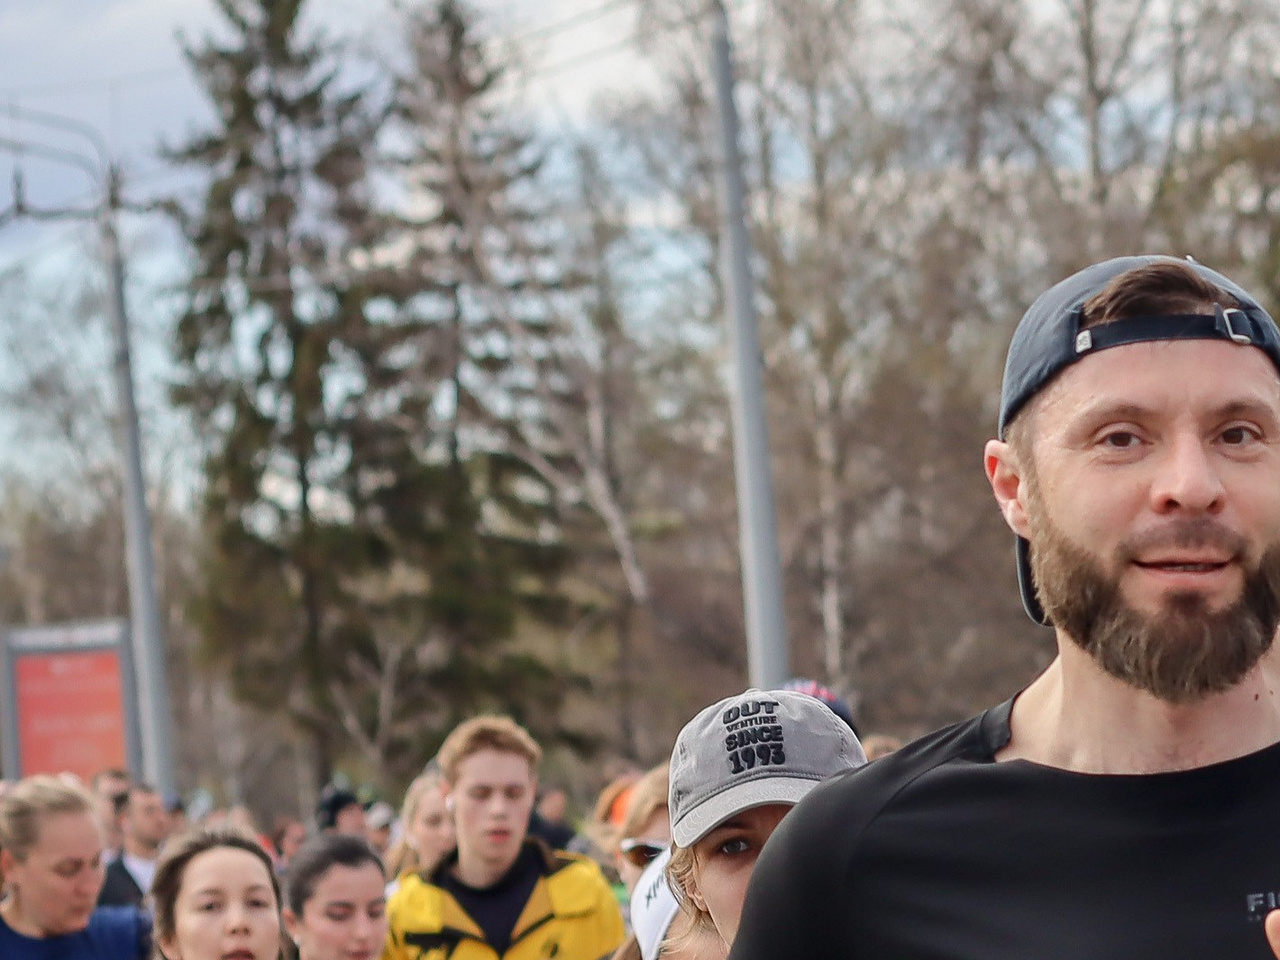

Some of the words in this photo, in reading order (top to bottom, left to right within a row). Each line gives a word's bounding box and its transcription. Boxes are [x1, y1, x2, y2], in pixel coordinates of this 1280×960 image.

[722, 701, 779, 724] OUT
[725, 715, 777, 733] VENTURE
[725, 726, 784, 752] SINCE
[728, 743, 786, 775] 1993
